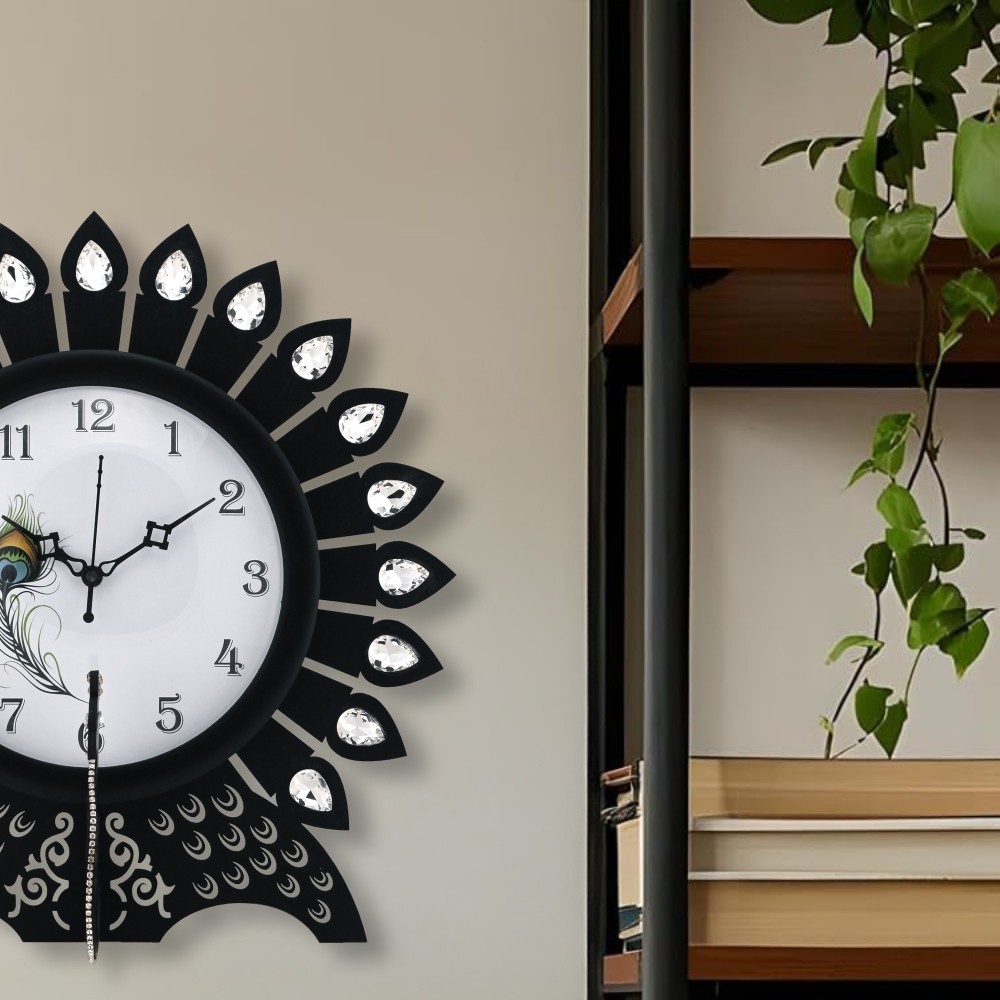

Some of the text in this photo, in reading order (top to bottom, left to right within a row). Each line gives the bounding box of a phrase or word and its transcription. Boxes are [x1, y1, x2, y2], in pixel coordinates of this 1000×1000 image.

[71, 398, 115, 432] 12
[163, 420, 181, 456] 1
[218, 479, 245, 516] 2
[242, 560, 269, 597] 3
[213, 638, 244, 676] 4
[155, 693, 184, 735] 5
[77, 720, 105, 755] 6
